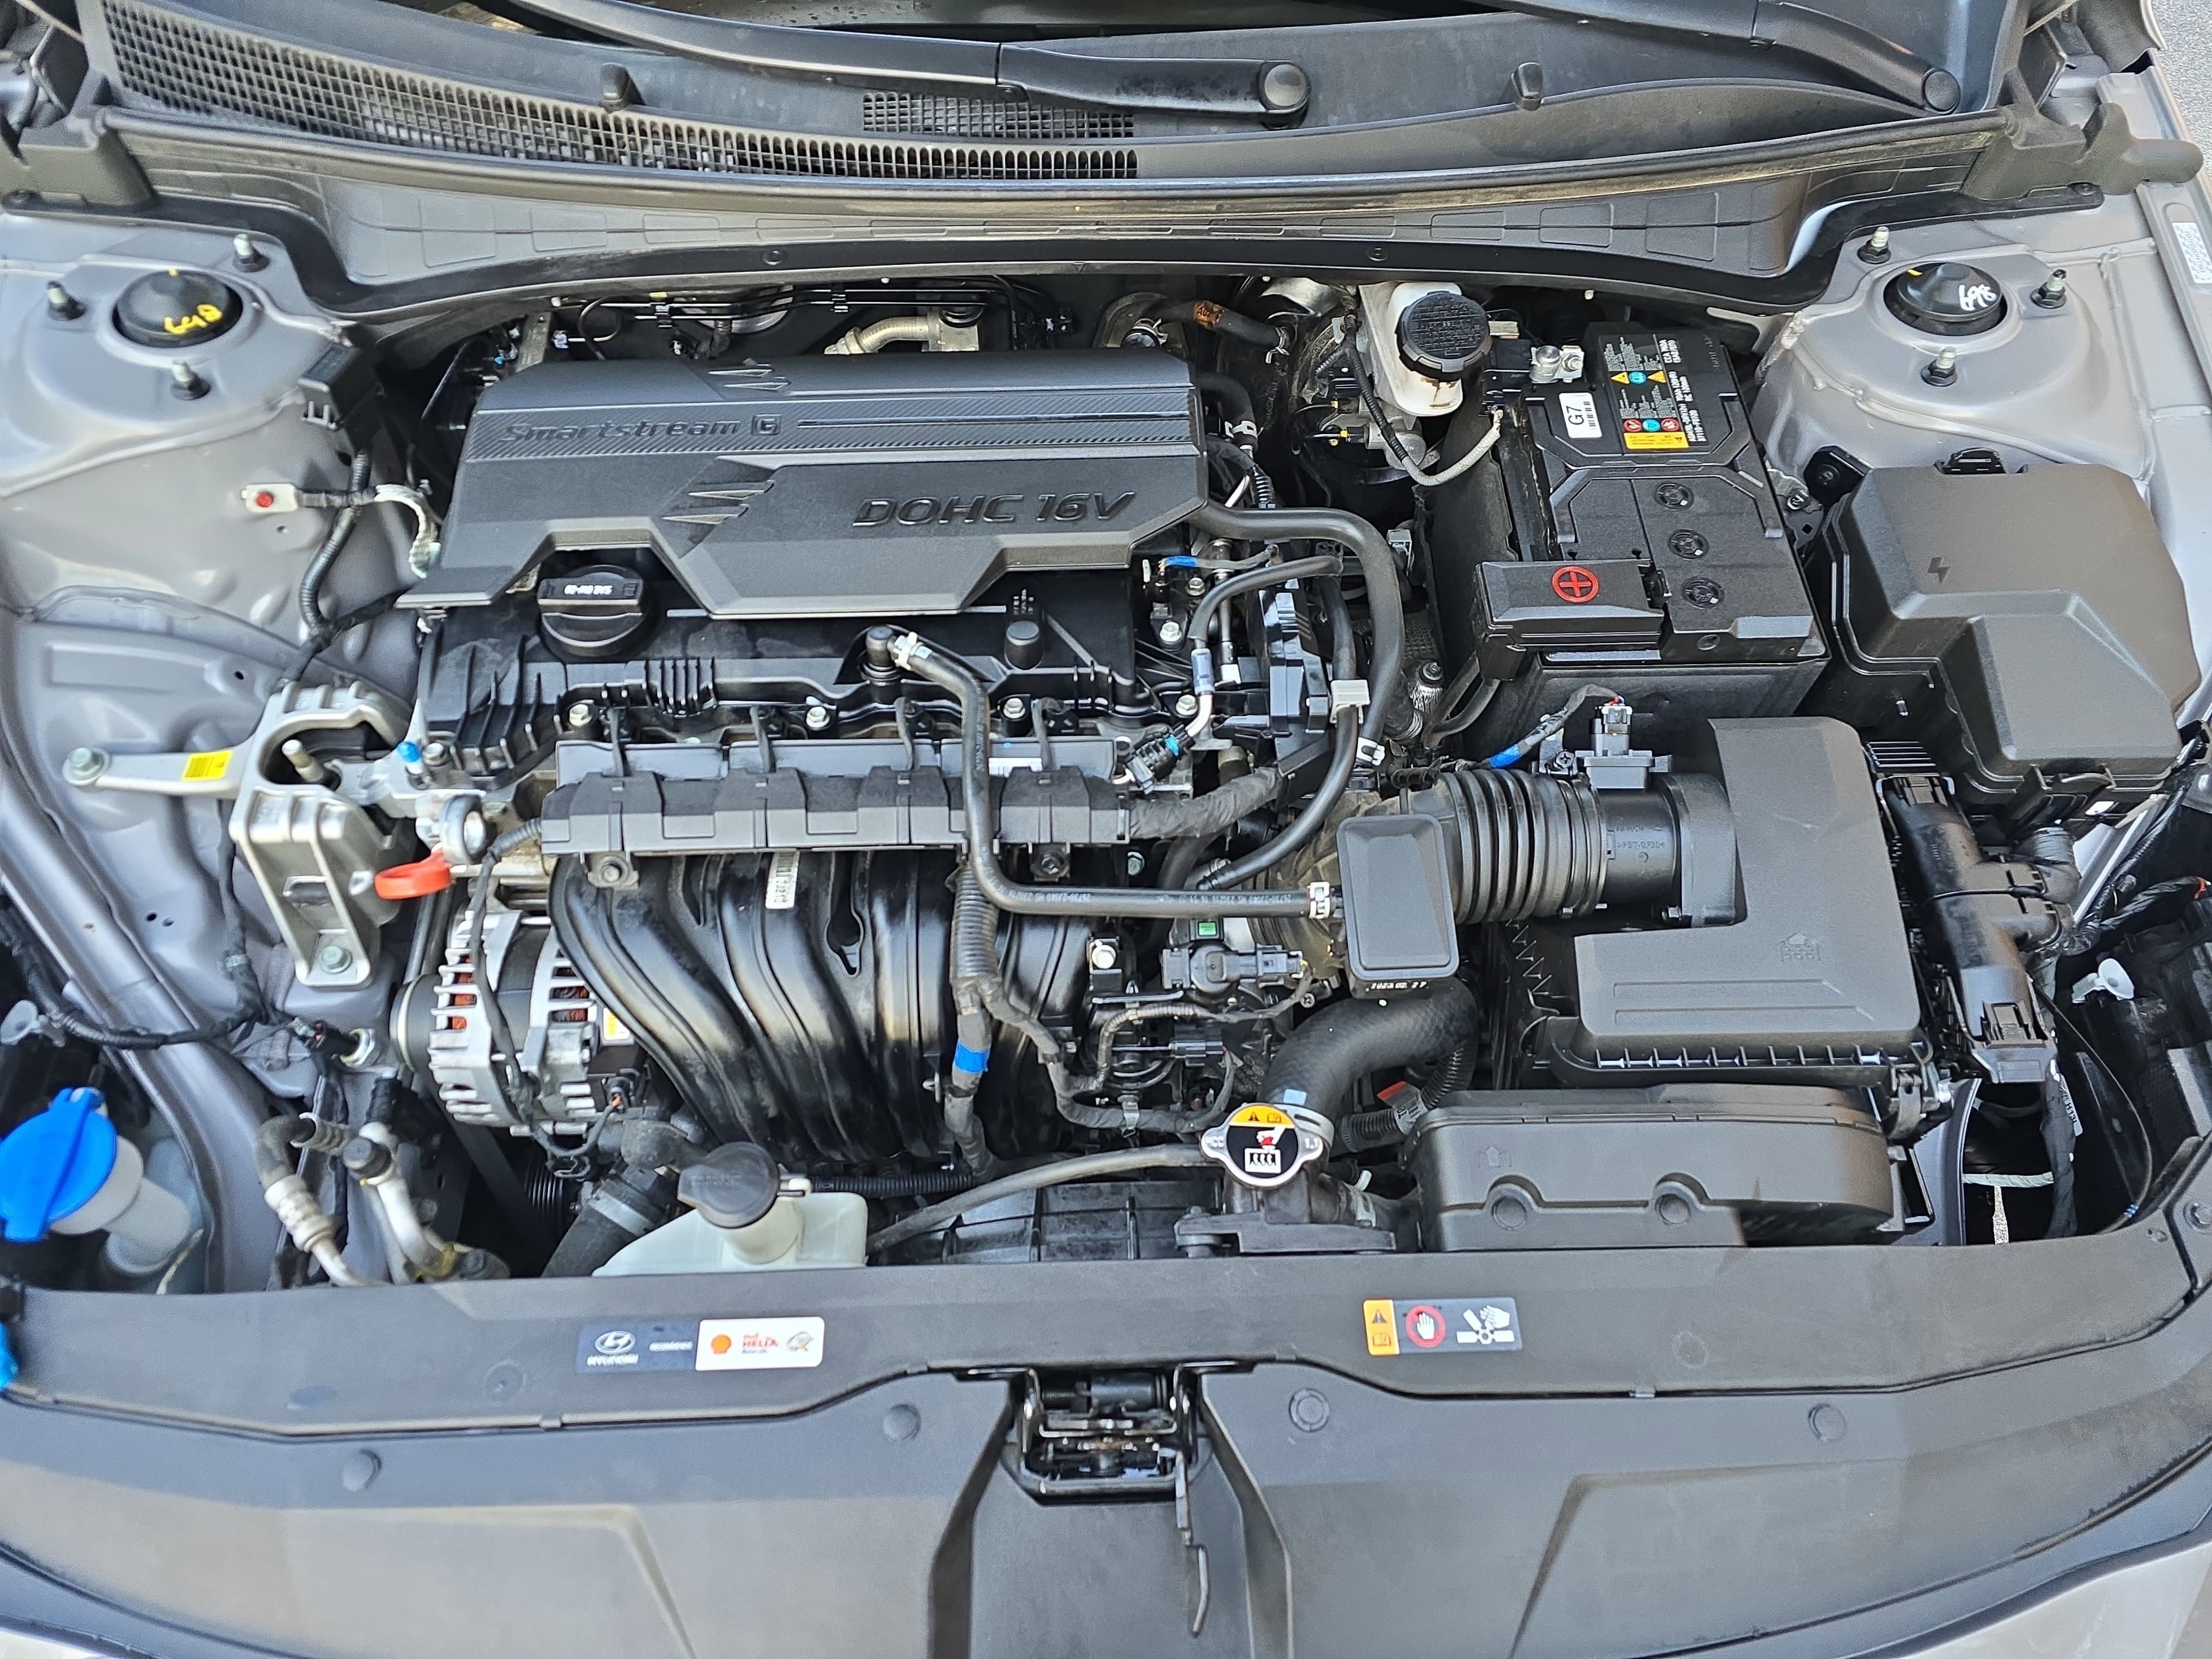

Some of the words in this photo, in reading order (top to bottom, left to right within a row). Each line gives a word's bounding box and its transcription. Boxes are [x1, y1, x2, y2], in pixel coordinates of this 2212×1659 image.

[1566, 405, 1585, 425] G7
[500, 420, 742, 442] Smartstream
[852, 494, 1024, 526] DOHC
[1036, 491, 1136, 522] 16V
